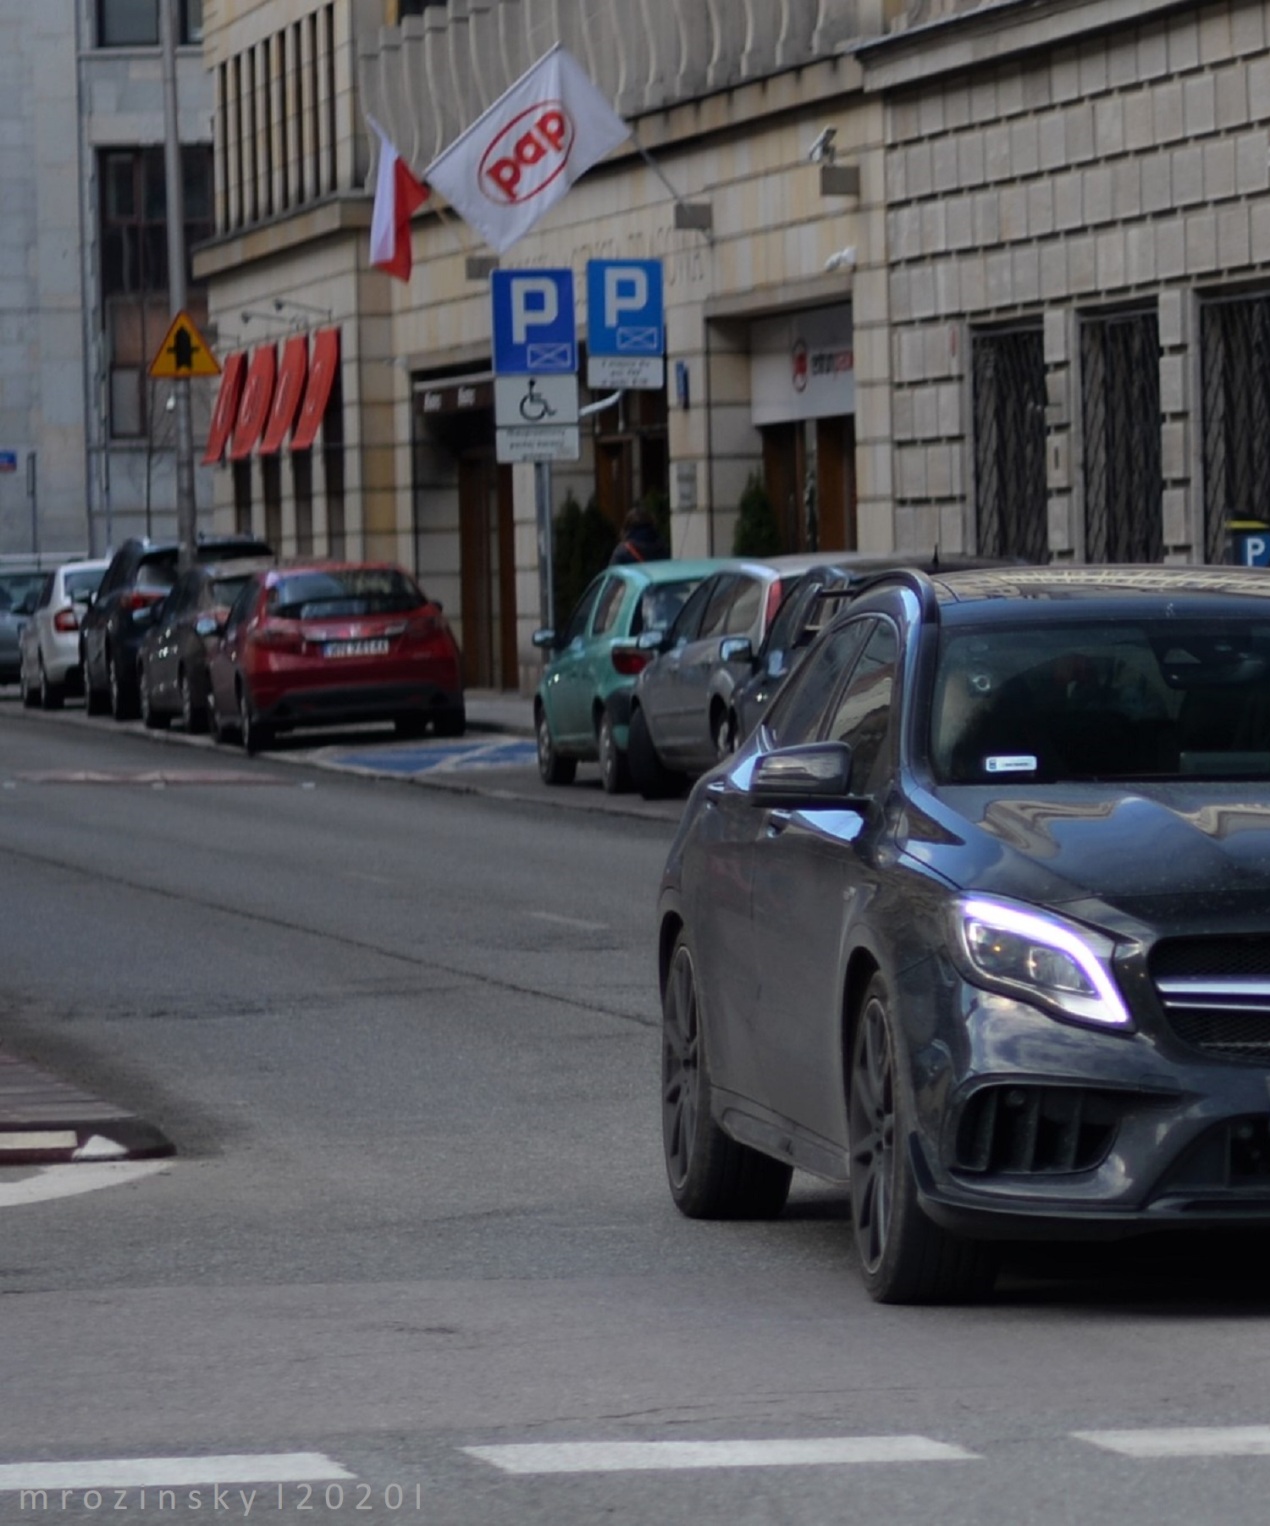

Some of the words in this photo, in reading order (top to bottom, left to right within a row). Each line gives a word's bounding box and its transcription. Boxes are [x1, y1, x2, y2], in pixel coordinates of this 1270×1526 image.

[486, 109, 565, 202] pap
[511, 277, 559, 345] P
[604, 266, 648, 328] P
[1247, 537, 1266, 567] P
